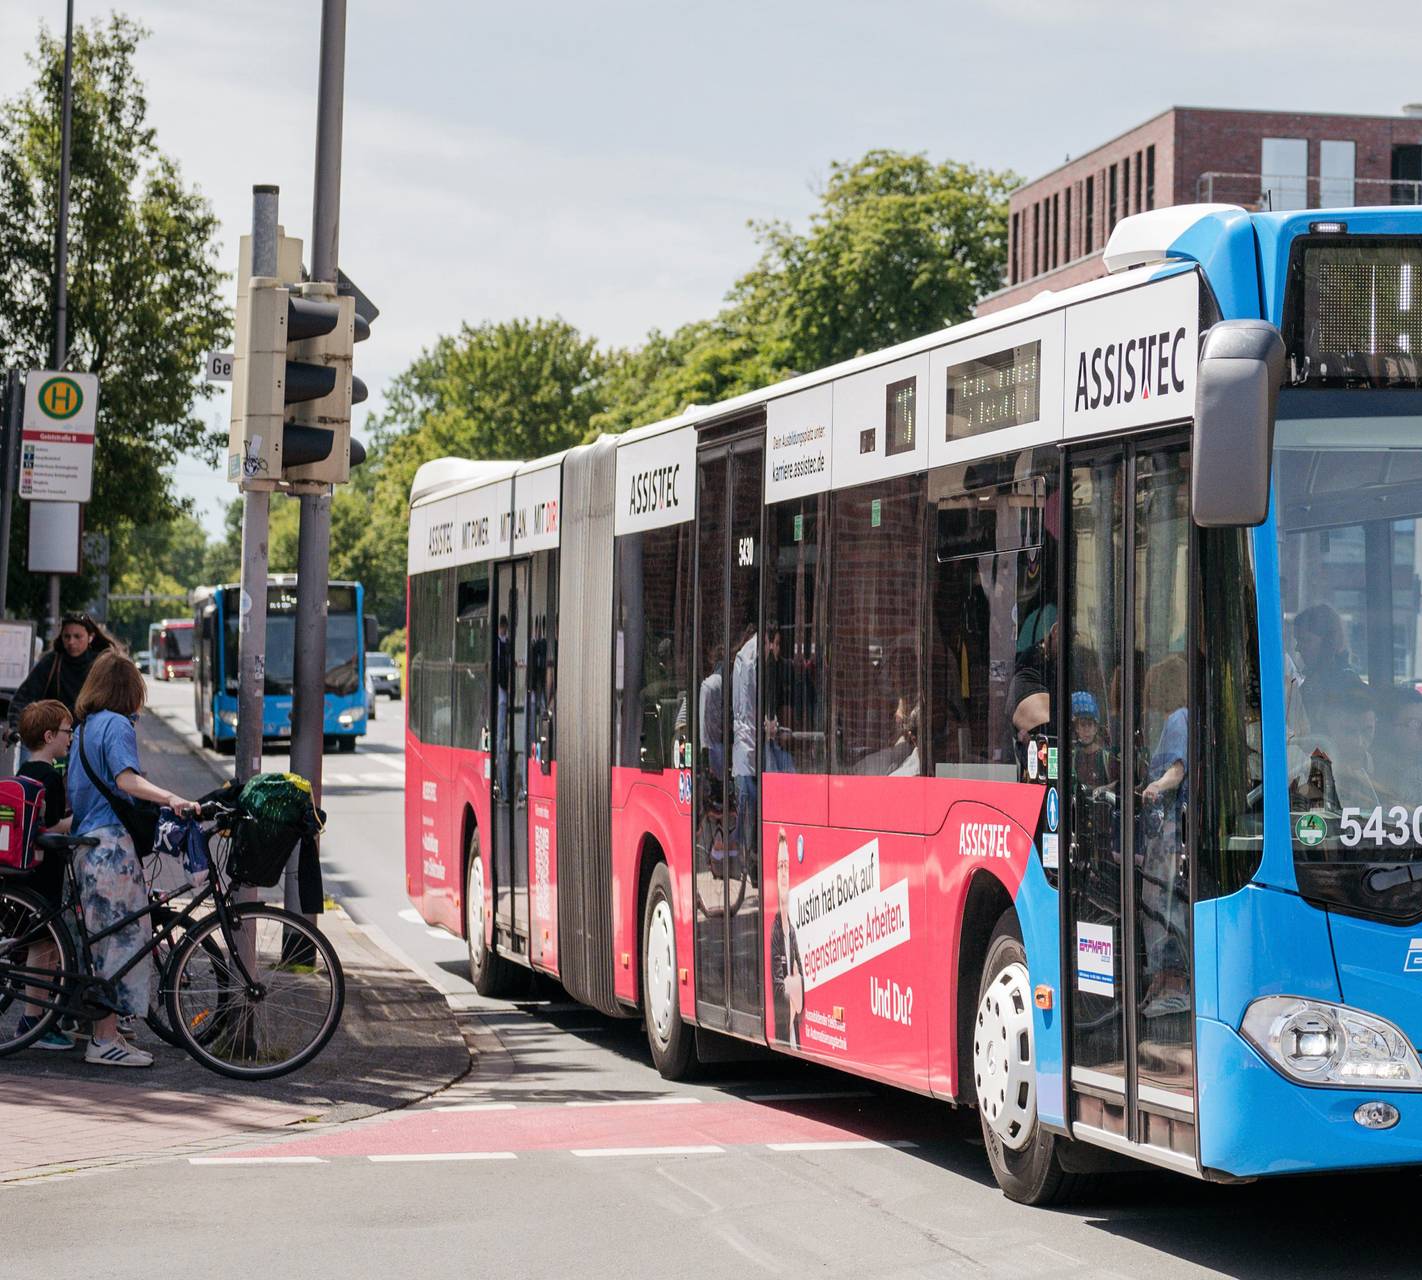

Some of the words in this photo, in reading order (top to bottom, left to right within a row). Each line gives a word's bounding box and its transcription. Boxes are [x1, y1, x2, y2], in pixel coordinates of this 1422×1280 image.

[213, 357, 231, 376] Ge
[1075, 327, 1186, 413] ASSISTEC
[772, 450, 825, 482] karriere.assistec.de
[629, 463, 680, 516] ASSISTEC
[534, 503, 545, 535] MIT
[739, 536, 754, 567] 5430
[959, 822, 1012, 859] ASSISTEC
[796, 888, 820, 930] Justin
[821, 880, 835, 916] hat
[836, 864, 859, 907] Bock
[860, 851, 874, 894] auf
[803, 922, 864, 983] eigenständiges
[866, 901, 904, 946] Arbeiten.
[870, 975, 891, 1020] Und
[892, 981, 913, 1027] Du?
